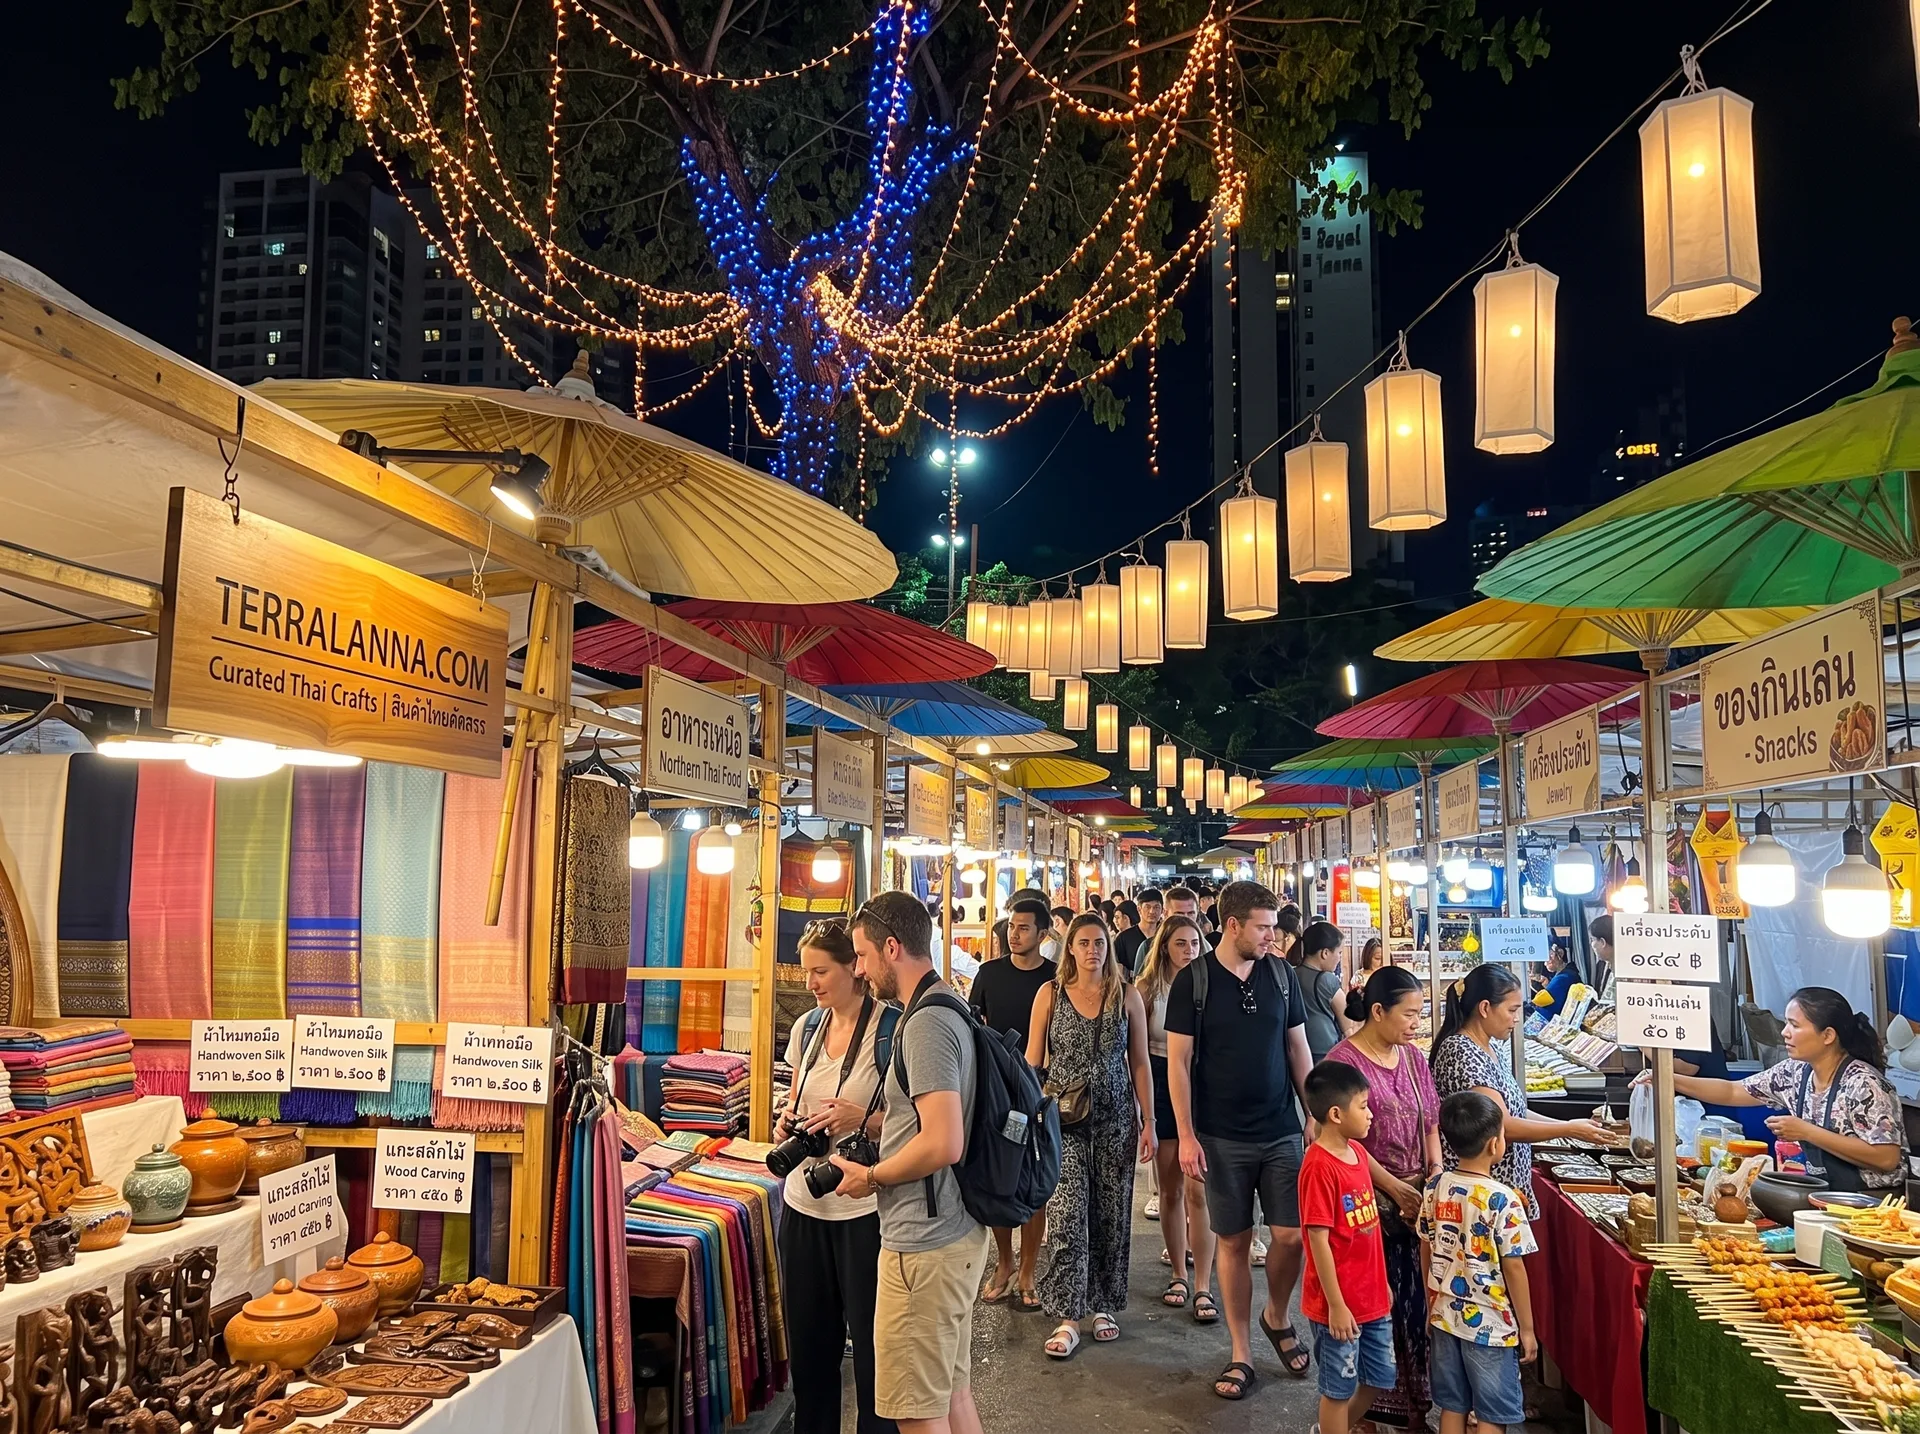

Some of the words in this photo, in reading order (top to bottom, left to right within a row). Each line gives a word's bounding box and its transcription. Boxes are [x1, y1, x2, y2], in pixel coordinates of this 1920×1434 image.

[215, 576, 489, 693] TERRALANNA.COM
[1714, 635, 1856, 730] ของกินเล่น
[209, 656, 285, 693] Curated
[290, 672, 326, 702] Thai
[331, 684, 378, 713] Crafts
[391, 694, 486, 735] สินค้าไทยคัดสรร
[1755, 725, 1818, 764] Snacks
[1529, 729, 1591, 781] เครื่องประดับ
[660, 750, 700, 779] Northern
[703, 761, 720, 783] Thai
[723, 766, 741, 788] Food
[1546, 782, 1573, 805] Jewelry
[1620, 918, 1711, 939] เครื่องประดับ
[1690, 952, 1702, 969] ฿
[1626, 994, 1701, 1010] ของกินเล่น
[204, 1026, 279, 1042] ผ้าไหมทอมือ
[307, 1022, 383, 1040] ผ้าไหมทอมือ
[1676, 1026, 1686, 1040] ฿
[198, 1051, 262, 1060] Handwoven
[264, 1050, 285, 1060] Silk
[300, 1046, 364, 1058] Handwoven
[367, 1049, 388, 1059] Silk
[453, 1055, 518, 1068] Handwoven
[521, 1059, 543, 1070] Silk
[197, 1070, 228, 1081] ราคา
[277, 1068, 284, 1082] ฿
[299, 1066, 329, 1078] ราคา
[377, 1067, 386, 1082] ฿
[450, 1076, 482, 1087] ราคา
[533, 1078, 542, 1094] ฿
[386, 1140, 466, 1161] แกะสลักไม้
[384, 1165, 417, 1177] Wood
[421, 1167, 465, 1183] Carving
[267, 1164, 330, 1204] แกะสลักไม้
[384, 1187, 416, 1199] ราคา
[454, 1187, 463, 1204] ฿
[268, 1208, 296, 1225] Wood
[298, 1195, 332, 1215] Carving
[270, 1229, 297, 1250] ราคา
[325, 1212, 332, 1231] ฿
